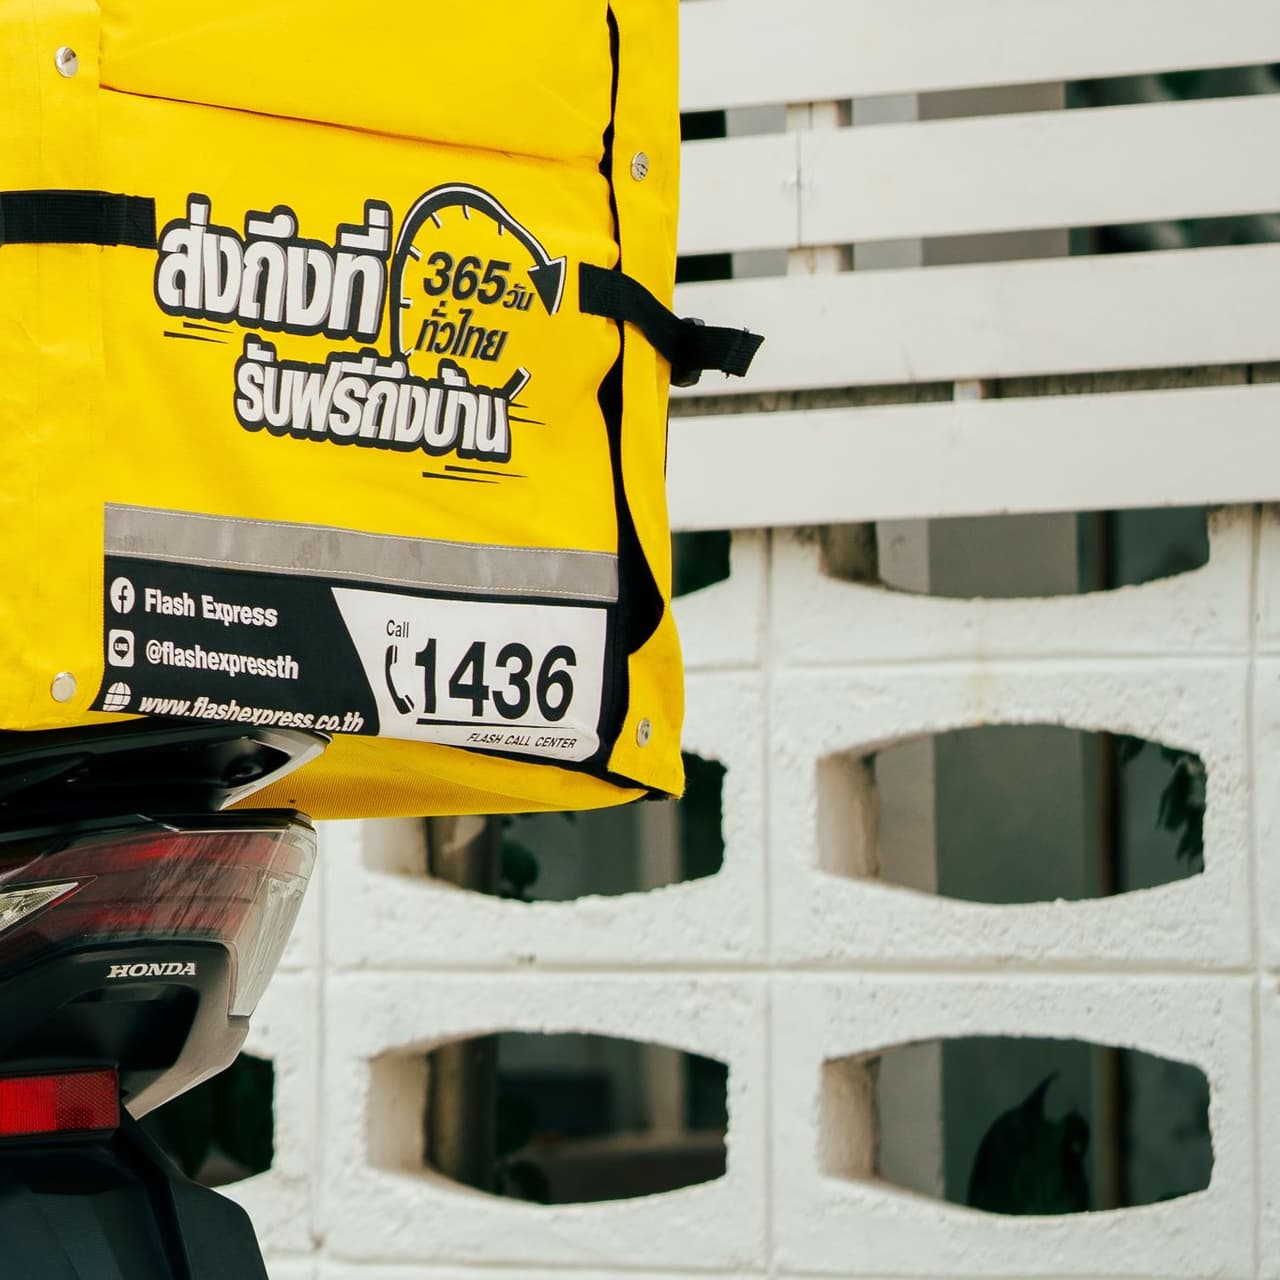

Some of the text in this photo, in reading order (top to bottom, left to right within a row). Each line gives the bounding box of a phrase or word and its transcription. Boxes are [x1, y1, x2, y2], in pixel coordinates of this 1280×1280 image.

[414, 301, 509, 362] ทั่วไทย
[144, 588, 279, 628] Flash Express
[386, 619, 410, 639] Call
[145, 638, 300, 680] @flashexpressth
[415, 637, 577, 722] 1436
[137, 695, 365, 733] www.flashexpress.co.th
[466, 732, 578, 749] FLASH CALL CENTER
[106, 961, 197, 979] HONDA
